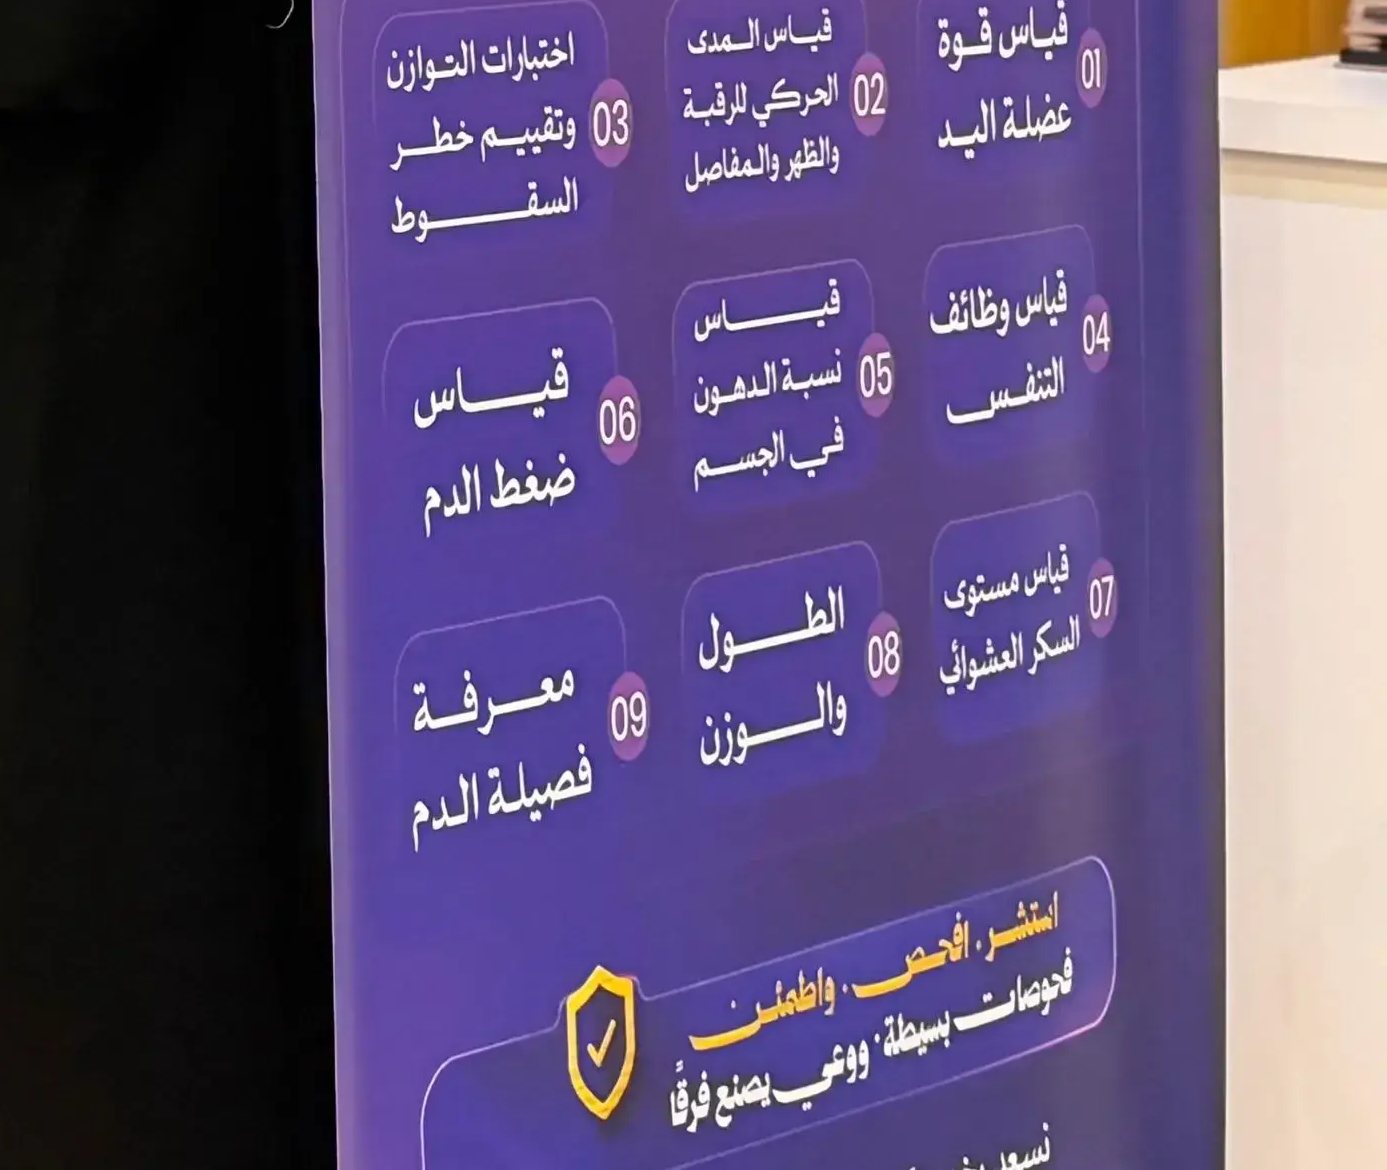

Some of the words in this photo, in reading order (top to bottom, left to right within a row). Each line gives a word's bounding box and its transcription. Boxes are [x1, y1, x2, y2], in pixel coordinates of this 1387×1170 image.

[482, 31, 574, 79] اختبارات
[688, 18, 759, 54] المدى
[765, 9, 831, 52] قياس
[938, 7, 992, 71] قوة
[999, 0, 1067, 58] قياس
[387, 40, 475, 92] التوازن
[1082, 48, 1100, 89] 01
[684, 82, 746, 126] للرقبة
[752, 73, 838, 127] الحركي
[854, 72, 885, 116] 02
[1003, 94, 1071, 141] عضلة
[390, 117, 473, 170] خطر
[481, 106, 576, 162] وتقييم
[594, 102, 628, 146] 03
[938, 103, 996, 159] اليد
[686, 144, 779, 192] والمفاصل
[785, 136, 839, 181] والظهر
[392, 176, 578, 242] السقوط
[695, 279, 840, 341] قياس
[930, 286, 1010, 336] وظائف
[1016, 269, 1067, 327] قياس
[1083, 313, 1110, 355] 04
[415, 348, 568, 428] قياس
[694, 362, 776, 416] الدهون
[782, 349, 841, 390] نسبة
[860, 352, 892, 397] 05
[947, 356, 1064, 424] التنفس
[600, 396, 636, 444] 06
[790, 416, 843, 477] في
[490, 454, 575, 507] ضغط
[695, 430, 784, 491] الجسم
[425, 467, 480, 537] الدم
[944, 572, 1019, 615] مستوى
[1025, 544, 1068, 596] قياس
[1090, 575, 1114, 619] 07
[699, 586, 844, 672] الطول
[868, 631, 900, 678] 08
[1028, 615, 1080, 674] السكر
[940, 632, 1023, 695] العشوائي
[414, 670, 574, 735] معرفة
[612, 691, 646, 741] 09
[701, 681, 846, 766] والوزن
[488, 744, 592, 822] فصيلة
[413, 773, 478, 852] الدم
[689, 967, 835, 1050] واطمئن
[949, 943, 1073, 1030] فحوصات
[715, 1073, 771, 1127] يصنع
[772, 1040, 869, 1111] ووعي
